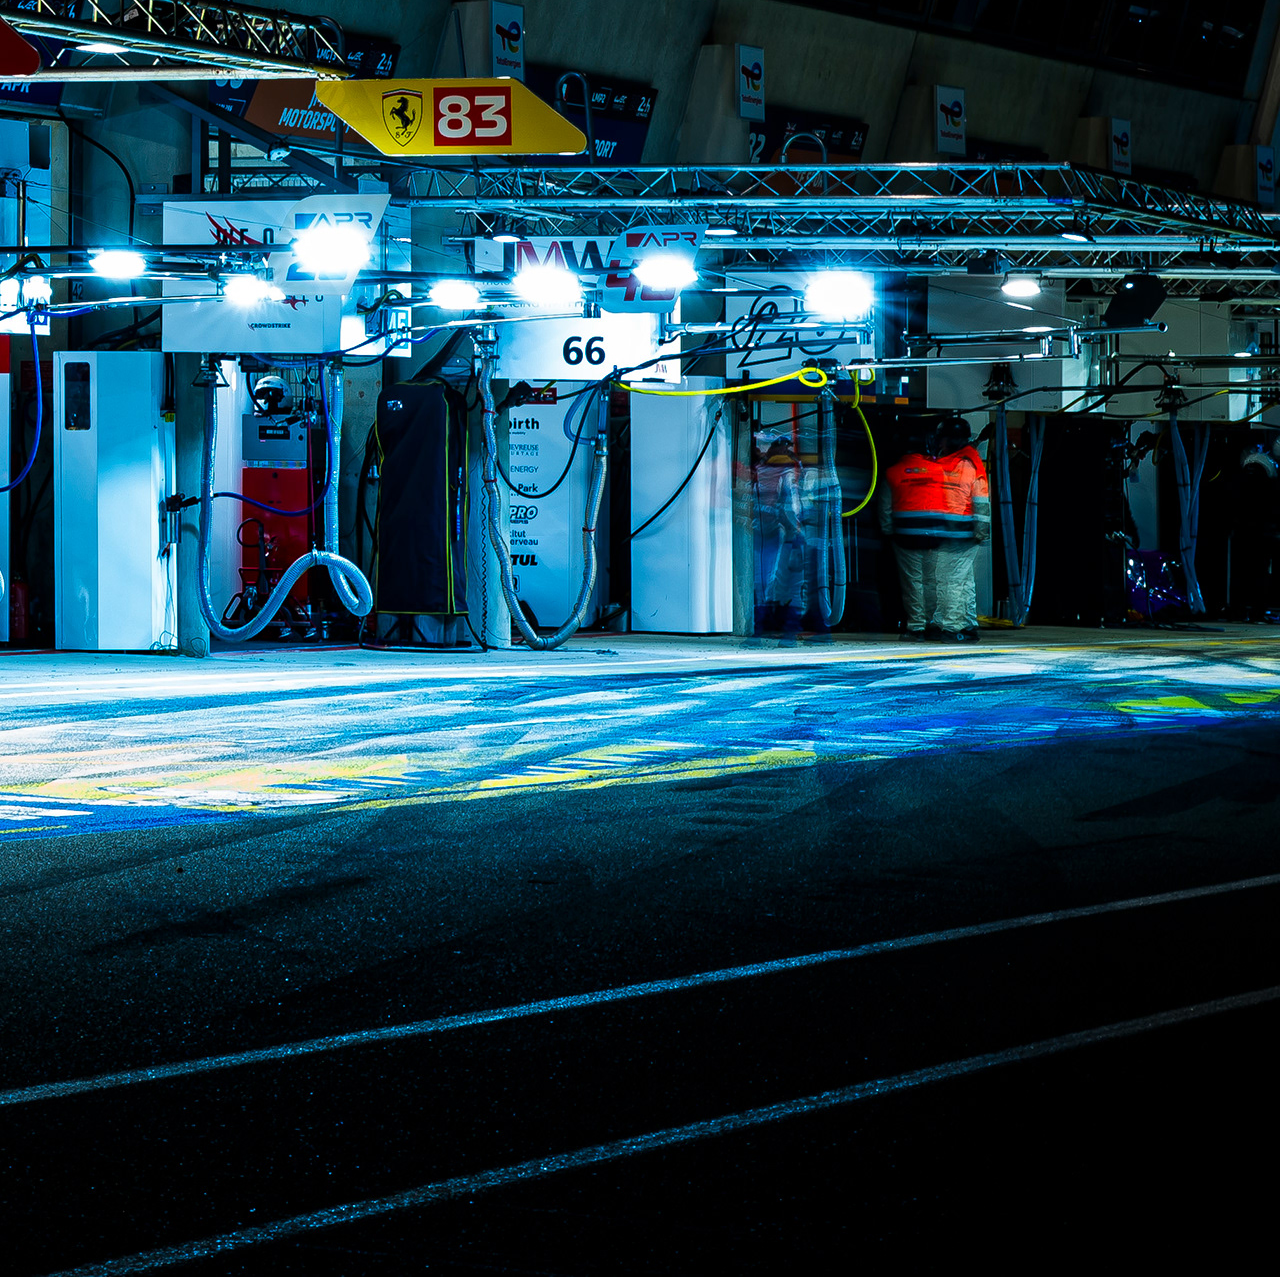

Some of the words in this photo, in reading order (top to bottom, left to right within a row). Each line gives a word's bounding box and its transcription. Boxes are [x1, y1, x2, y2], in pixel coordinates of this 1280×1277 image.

[438, 95, 507, 138] 83
[643, 232, 698, 247] APR
[72, 283, 83, 300] 42
[563, 337, 606, 365] 66
[519, 484, 539, 493] Park
